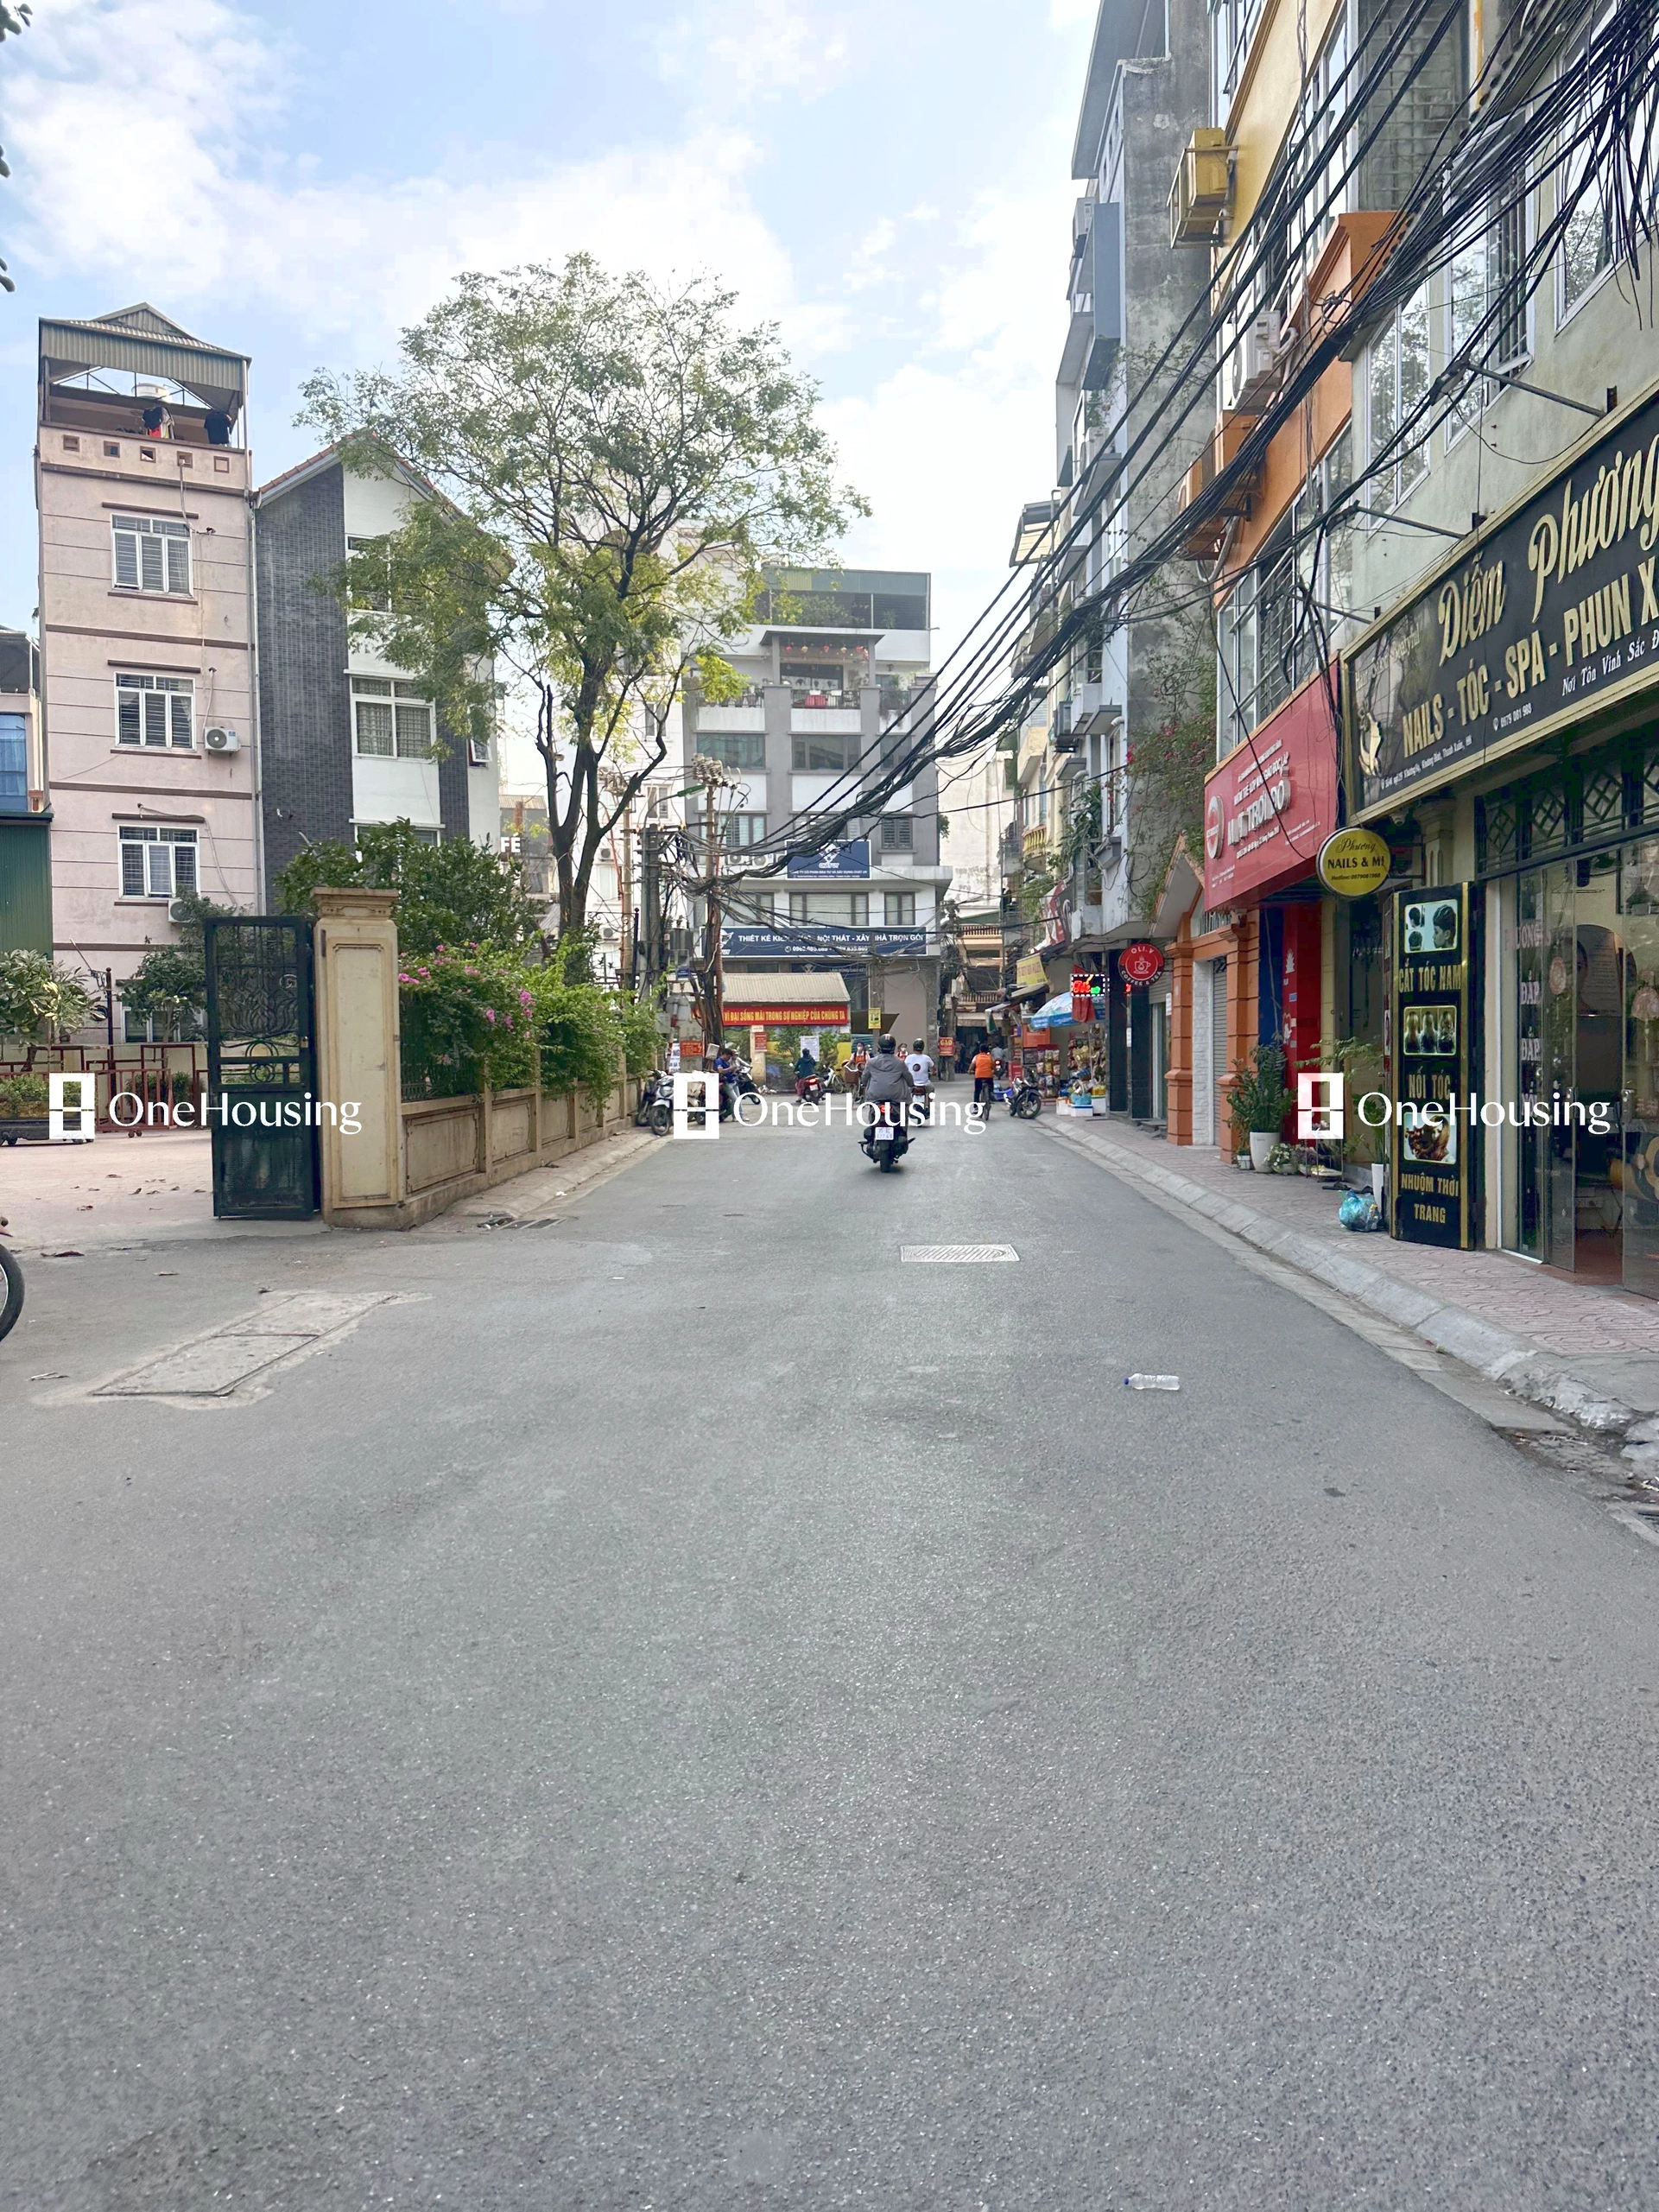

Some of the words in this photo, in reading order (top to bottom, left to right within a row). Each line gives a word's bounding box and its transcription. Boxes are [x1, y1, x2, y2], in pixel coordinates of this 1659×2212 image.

[1438, 550, 1507, 667] Diễm
[1528, 434, 1659, 624] Phương
[1403, 693, 1444, 758] NAILS
[1457, 658, 1489, 726] TÓC
[1505, 630, 1546, 699] SPA
[1564, 573, 1632, 667] PHUN
[1580, 666, 1597, 687] Tôn
[1601, 649, 1622, 675] Vinh
[1627, 636, 1646, 662] Sắc
[1327, 857, 1358, 869] NAILS
[1361, 857, 1369, 867] &
[738, 934, 760, 942] THIẾT
[761, 934, 771, 942] KẾ
[1121, 970, 1143, 986] COFFEE
[1151, 971, 1162, 982] TEA
[1399, 958, 1414, 993] CẮT
[1418, 960, 1436, 992] TÓC
[1439, 964, 1461, 991] NAM
[740, 1008, 754, 1021] SỐNG
[755, 1010, 765, 1021] MÃI
[766, 1011, 782, 1021] TRONG
[782, 1011, 790, 1023] SỰ
[791, 1009, 809, 1023] NGHIỆP
[810, 1008, 820, 1020] CỦA
[821, 1008, 839, 1020] CHÚNG
[839, 1010, 845, 1019] TA
[1409, 1066, 1427, 1099] NỐI
[1432, 1068, 1452, 1100] TÓC
[1401, 1173, 1434, 1196] NHUỘM
[1437, 1175, 1459, 1197] THỜI
[1414, 1203, 1447, 1224] TRANG
